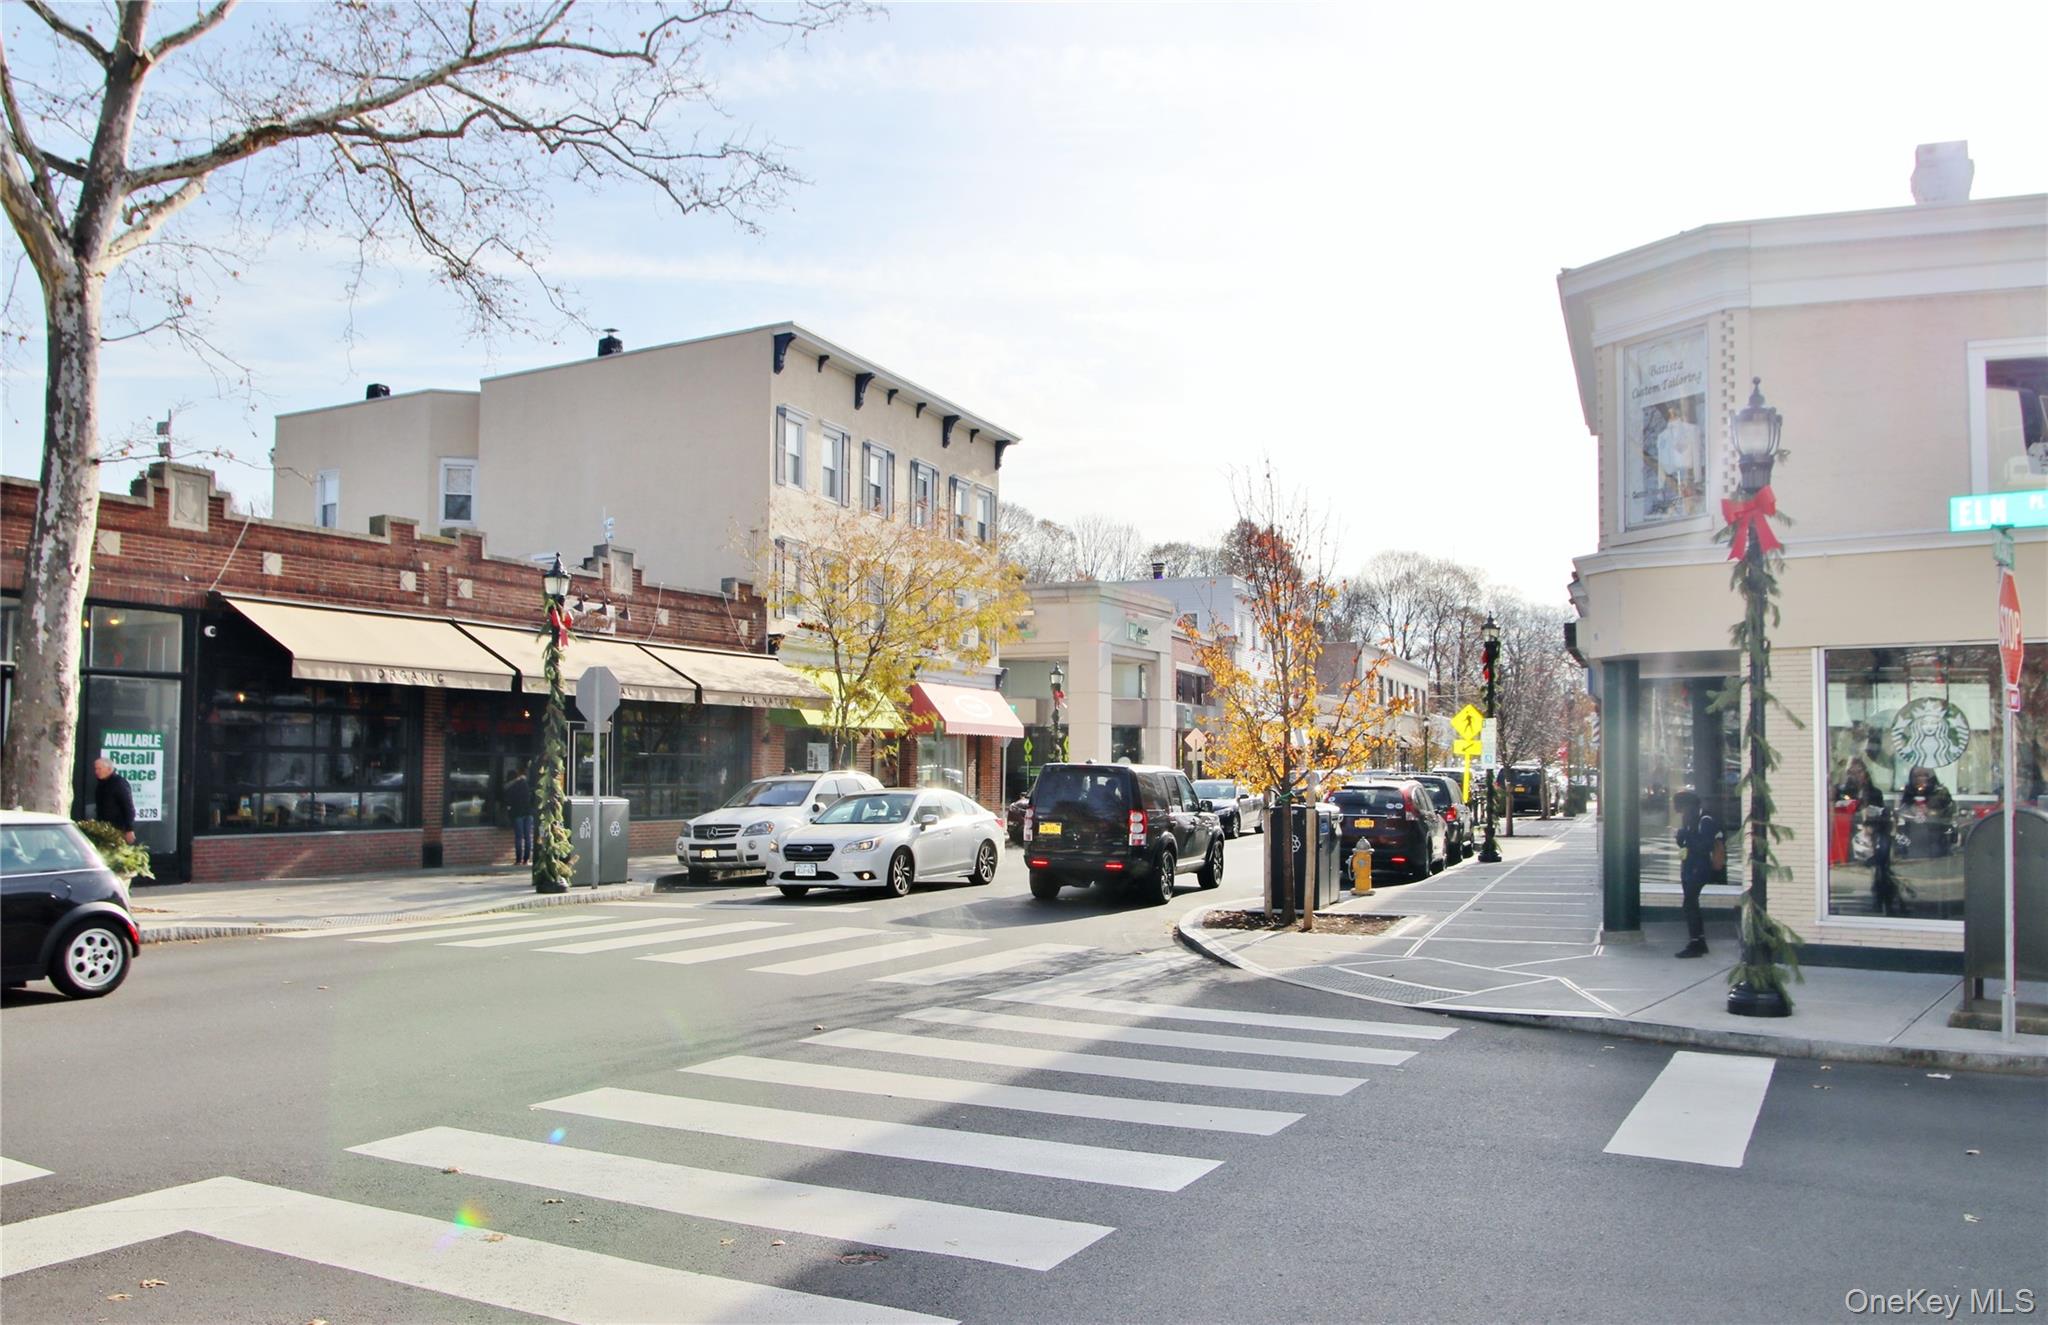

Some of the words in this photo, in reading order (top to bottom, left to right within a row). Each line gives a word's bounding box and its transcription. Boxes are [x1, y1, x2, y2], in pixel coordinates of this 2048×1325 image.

[1959, 498, 2007, 527] ELM
[2000, 604, 2020, 651] STOP
[378, 668, 444, 683] ORGANIC
[741, 696, 756, 705] ALL
[104, 732, 161, 748] AVAILABLE
[109, 751, 155, 765] Retail
[115, 768, 157, 781] pace
